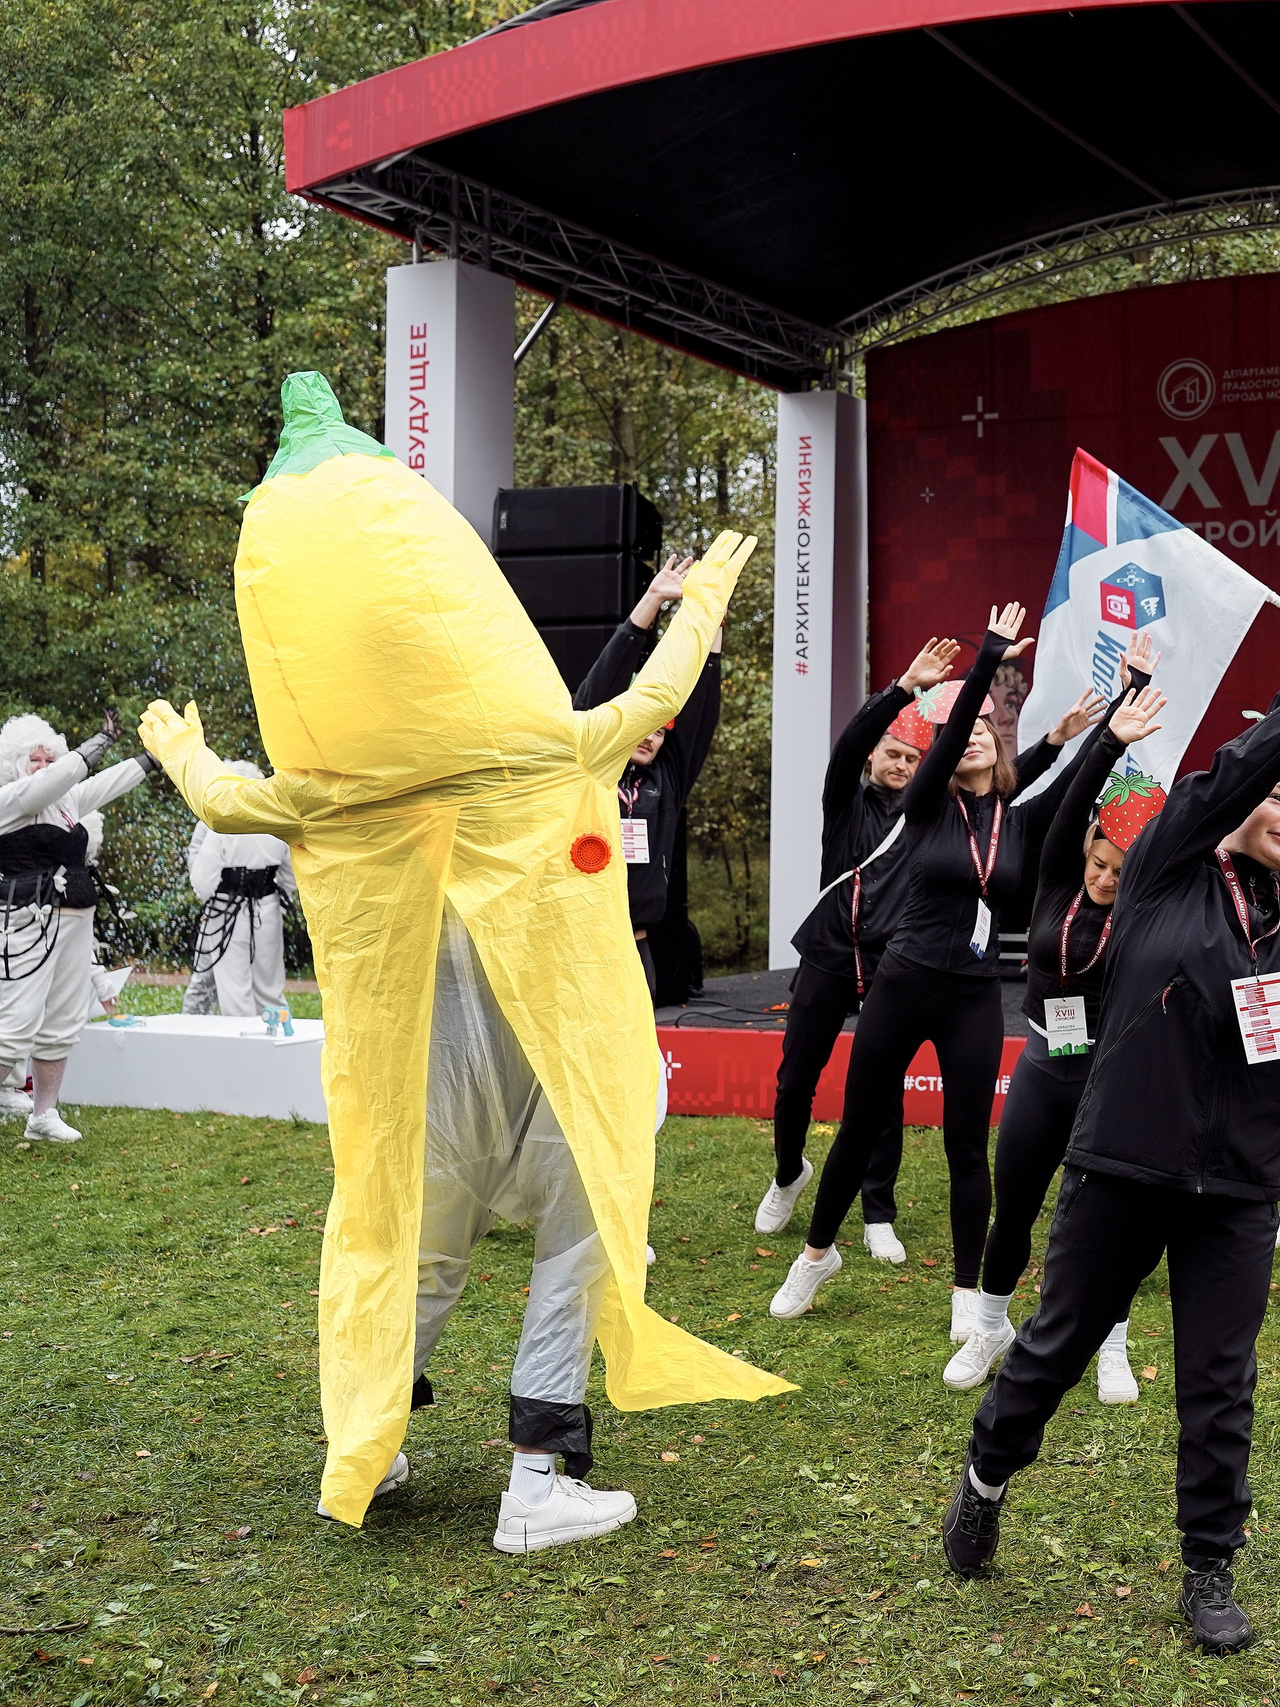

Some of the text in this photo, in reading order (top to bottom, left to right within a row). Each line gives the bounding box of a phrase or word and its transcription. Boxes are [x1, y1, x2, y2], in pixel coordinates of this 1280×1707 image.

[409, 323, 430, 471] БУДУЩЕЕ
[1222, 391, 1264, 403] ГОРОДА
[795, 435, 812, 676] #АРХИТЕКТОРЖИЗНИ
[1055, 1009, 1075, 1018] XVIII
